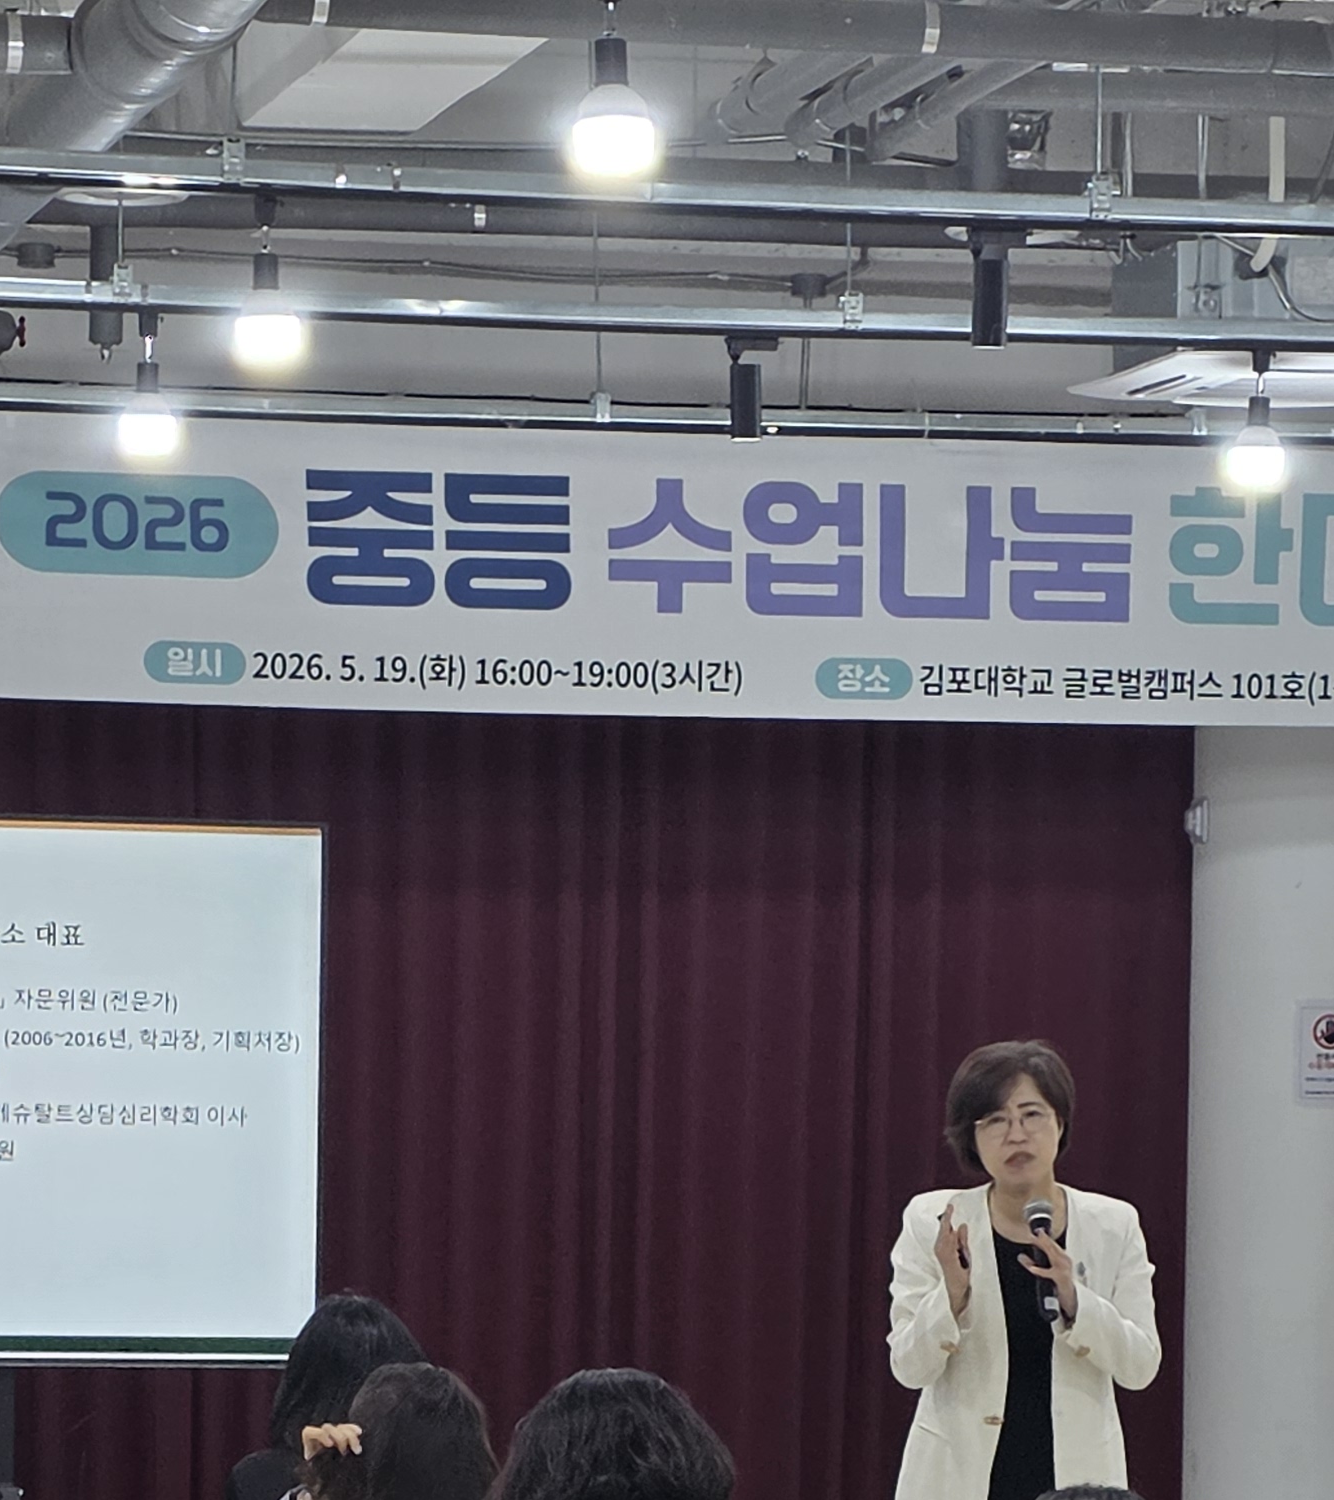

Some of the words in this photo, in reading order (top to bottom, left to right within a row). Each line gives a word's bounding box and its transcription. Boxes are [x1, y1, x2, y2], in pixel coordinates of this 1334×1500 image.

[44, 490, 230, 553] 2026
[306, 468, 572, 611] 중등
[608, 476, 1134, 623] 수업나눔
[166, 645, 223, 678] 일시
[251, 651, 332, 682] 2026.
[339, 654, 366, 682] 5.
[373, 653, 466, 692] 19.(화)
[475, 656, 743, 697] 16:00~19:00(3시간)
[836, 663, 892, 694] 장소
[919, 664, 1055, 698] 김포대학교
[1062, 667, 1224, 701] 글로벌캠퍼스
[34, 921, 86, 947] 대표
[14, 988, 96, 1012] 자문위원
[102, 991, 178, 1015] (전문가)
[138, 1028, 206, 1052] 학과장,
[212, 1029, 300, 1054] 기획처장)
[207, 1105, 248, 1128] 이사
